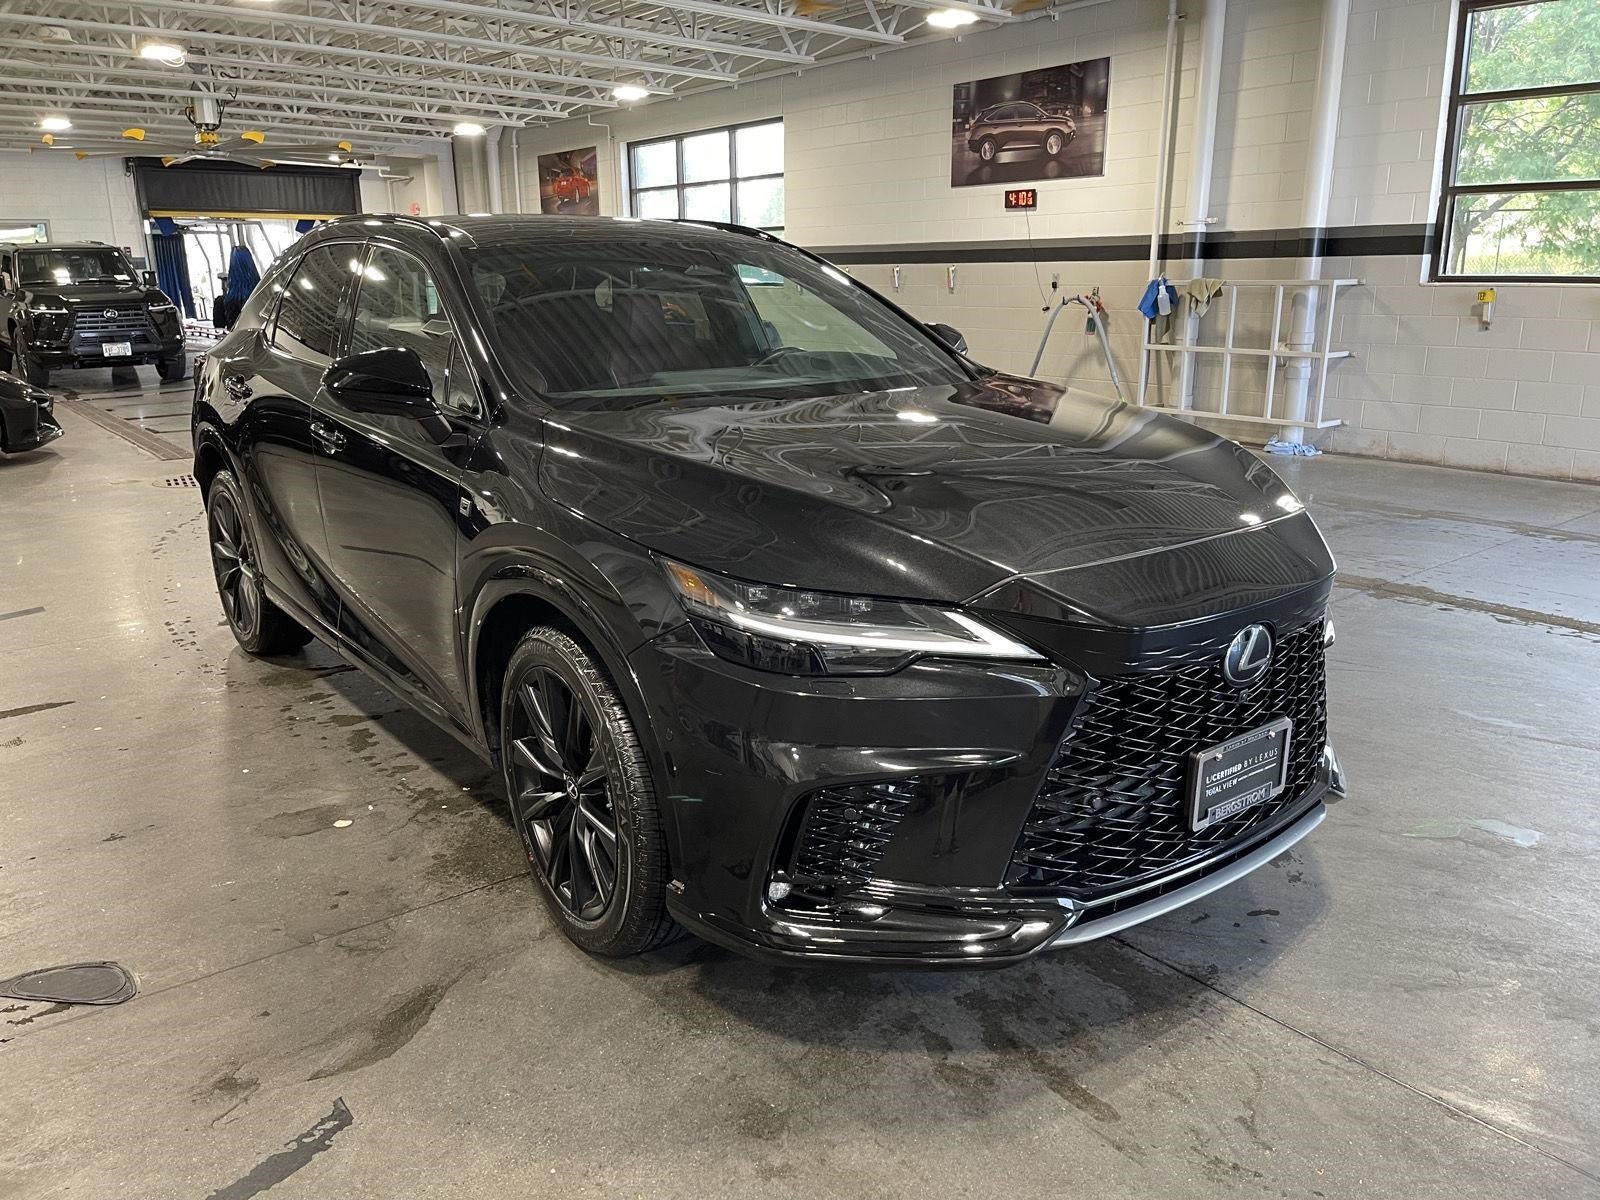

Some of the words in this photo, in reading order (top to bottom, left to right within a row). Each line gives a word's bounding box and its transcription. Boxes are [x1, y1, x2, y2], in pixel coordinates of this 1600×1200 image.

[1243, 758, 1253, 768] BY
[1255, 747, 1278, 763] LEXUS
[1222, 777, 1238, 790] VIEW
[1215, 787, 1266, 819] BERGSTROM
